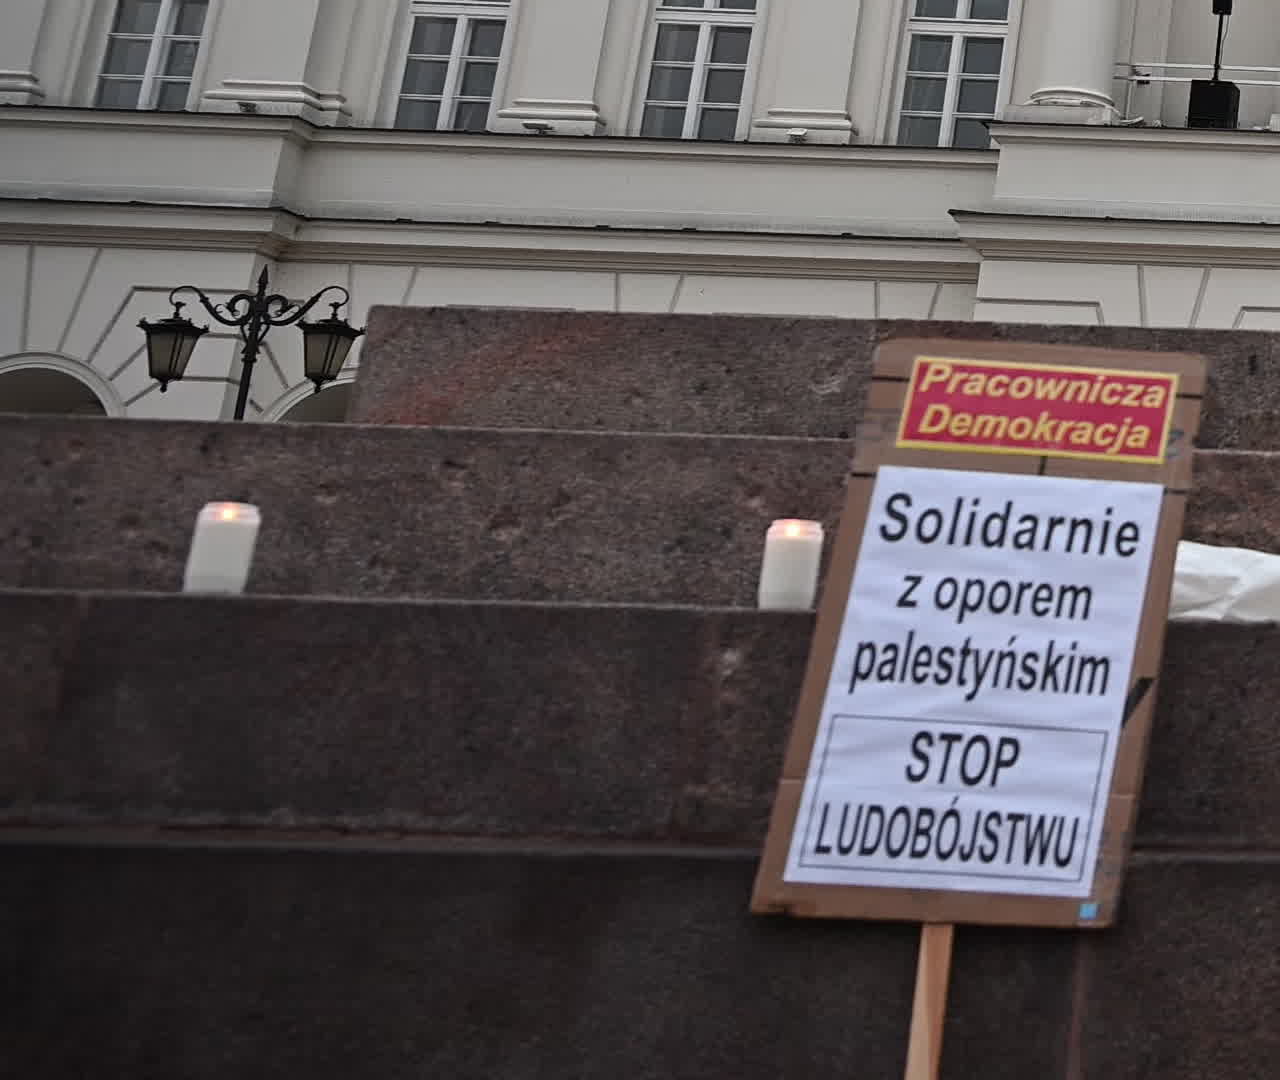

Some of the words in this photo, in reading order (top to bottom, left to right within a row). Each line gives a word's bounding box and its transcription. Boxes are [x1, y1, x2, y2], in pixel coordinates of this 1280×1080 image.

[919, 363, 1166, 409] Pracownicza
[918, 403, 1151, 454] Demokracja
[879, 492, 1140, 558] Solidarnie
[896, 575, 922, 609] z
[934, 577, 1093, 624] oporem
[848, 630, 1110, 702] palestyńskim
[905, 730, 1021, 788] STOP
[813, 796, 1079, 869] LUDOBÓJSTWU
